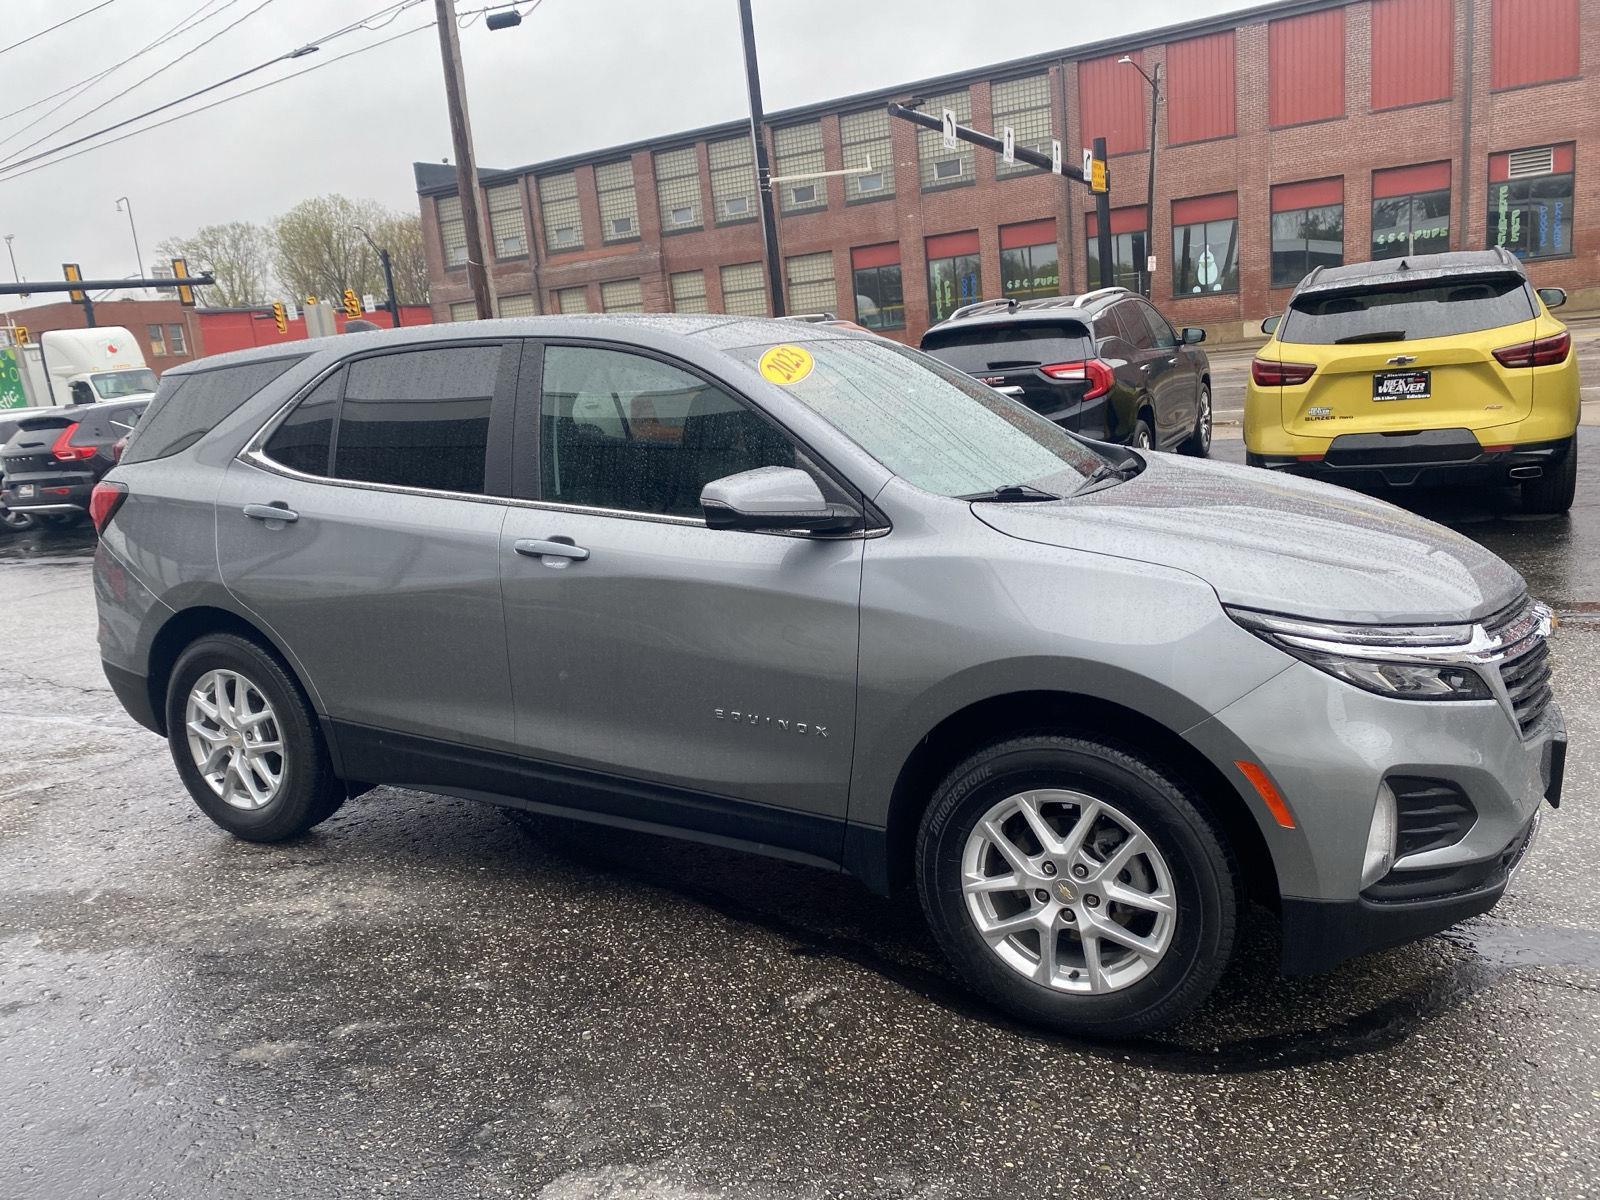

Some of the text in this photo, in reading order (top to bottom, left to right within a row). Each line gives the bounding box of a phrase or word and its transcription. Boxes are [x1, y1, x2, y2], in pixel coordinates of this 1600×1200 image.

[1414, 227, 1448, 240] PUPS
[1034, 276, 1058, 286] PUPS
[766, 348, 805, 381] 2023
[1378, 382, 1426, 393] WEAVER
[1383, 378, 1406, 389] RICK
[714, 708, 828, 737] EQUINOX
